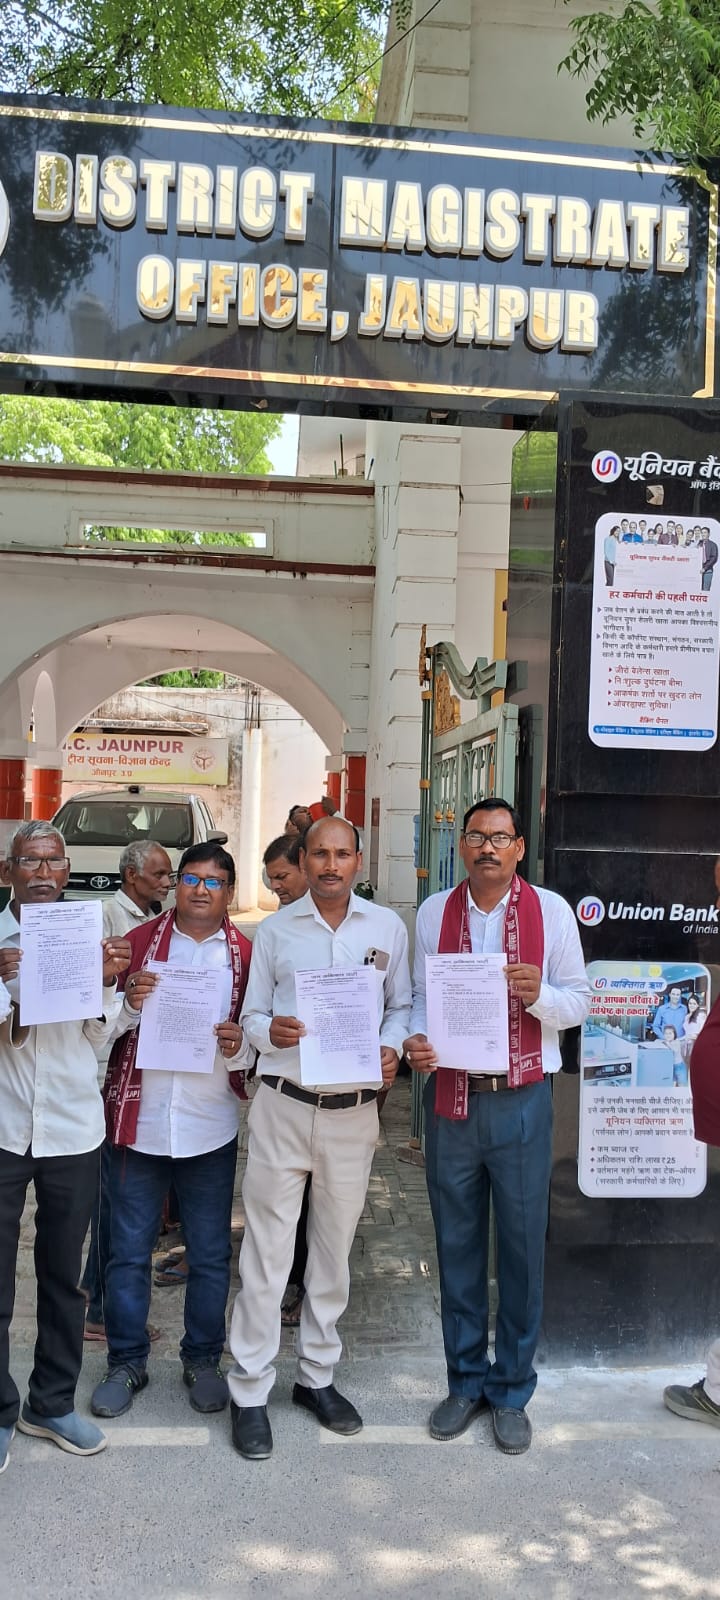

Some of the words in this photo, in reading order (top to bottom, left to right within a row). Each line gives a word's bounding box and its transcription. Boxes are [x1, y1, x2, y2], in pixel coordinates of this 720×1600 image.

[33, 151, 315, 242] DISTRICT
[339, 175, 690, 273] MAGISTRATE
[136, 254, 349, 342] OFFICE,
[358, 273, 599, 353] JAUNPUR
[623, 451, 697, 481] यूनियन
[609, 591, 619, 599] हर
[623, 589, 652, 600] कर्मचारी
[656, 590, 665, 600] की
[668, 592, 687, 602] पहली
[653, 668, 670, 676] खाता
[97, 739, 184, 753] JAUNPUR
[608, 901, 665, 921] Union
[669, 903, 720, 922] Bank
[682, 924, 693, 934] of
[695, 925, 719, 934] India
[610, 978, 646, 989] व्यक्तिगत
[604, 995, 627, 1004] आपका
[630, 994, 652, 1004] परिवार
[653, 995, 660, 1004] है
[616, 1007, 624, 1015] का
[606, 1116, 630, 1127] यूनियन
[634, 1116, 666, 1125] व्यक्तिगत
